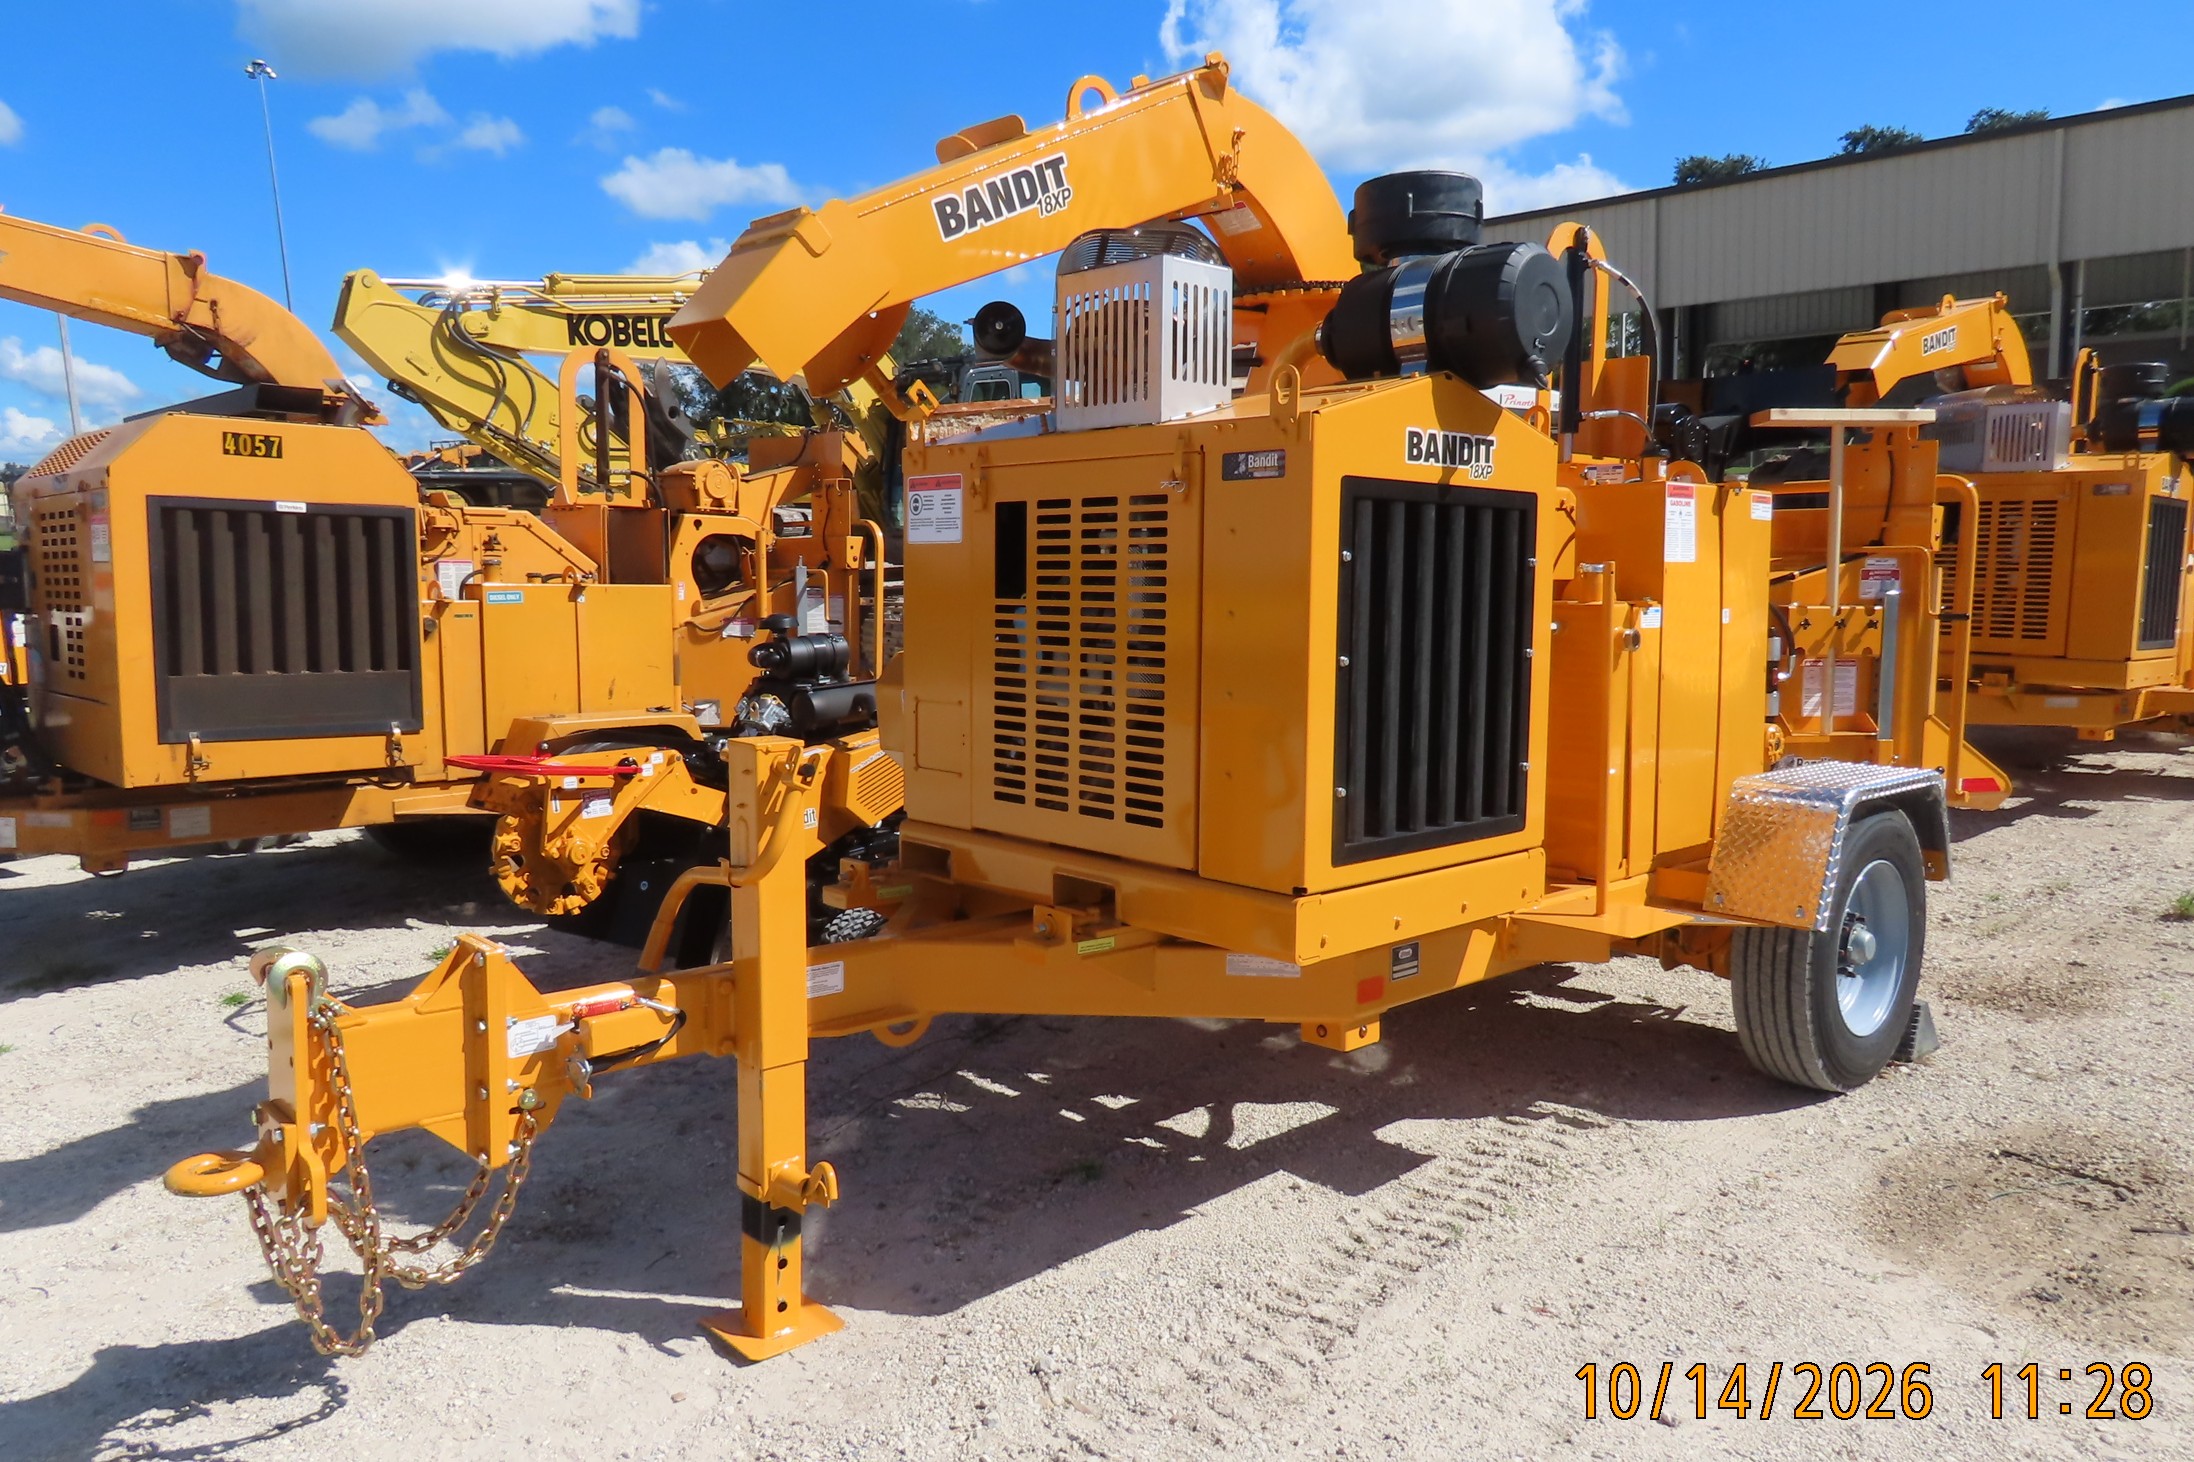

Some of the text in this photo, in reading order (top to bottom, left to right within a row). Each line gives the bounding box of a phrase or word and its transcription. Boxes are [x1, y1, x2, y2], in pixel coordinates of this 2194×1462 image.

[933, 155, 1066, 239] BANDIT
[1037, 188, 1072, 217] 18XP
[1922, 327, 1956, 355] BANDIT
[224, 432, 281, 457] 4057
[1407, 430, 1495, 466] BANDIT
[1248, 453, 1279, 468] Bandit
[1469, 464, 1493, 480] 18XP
